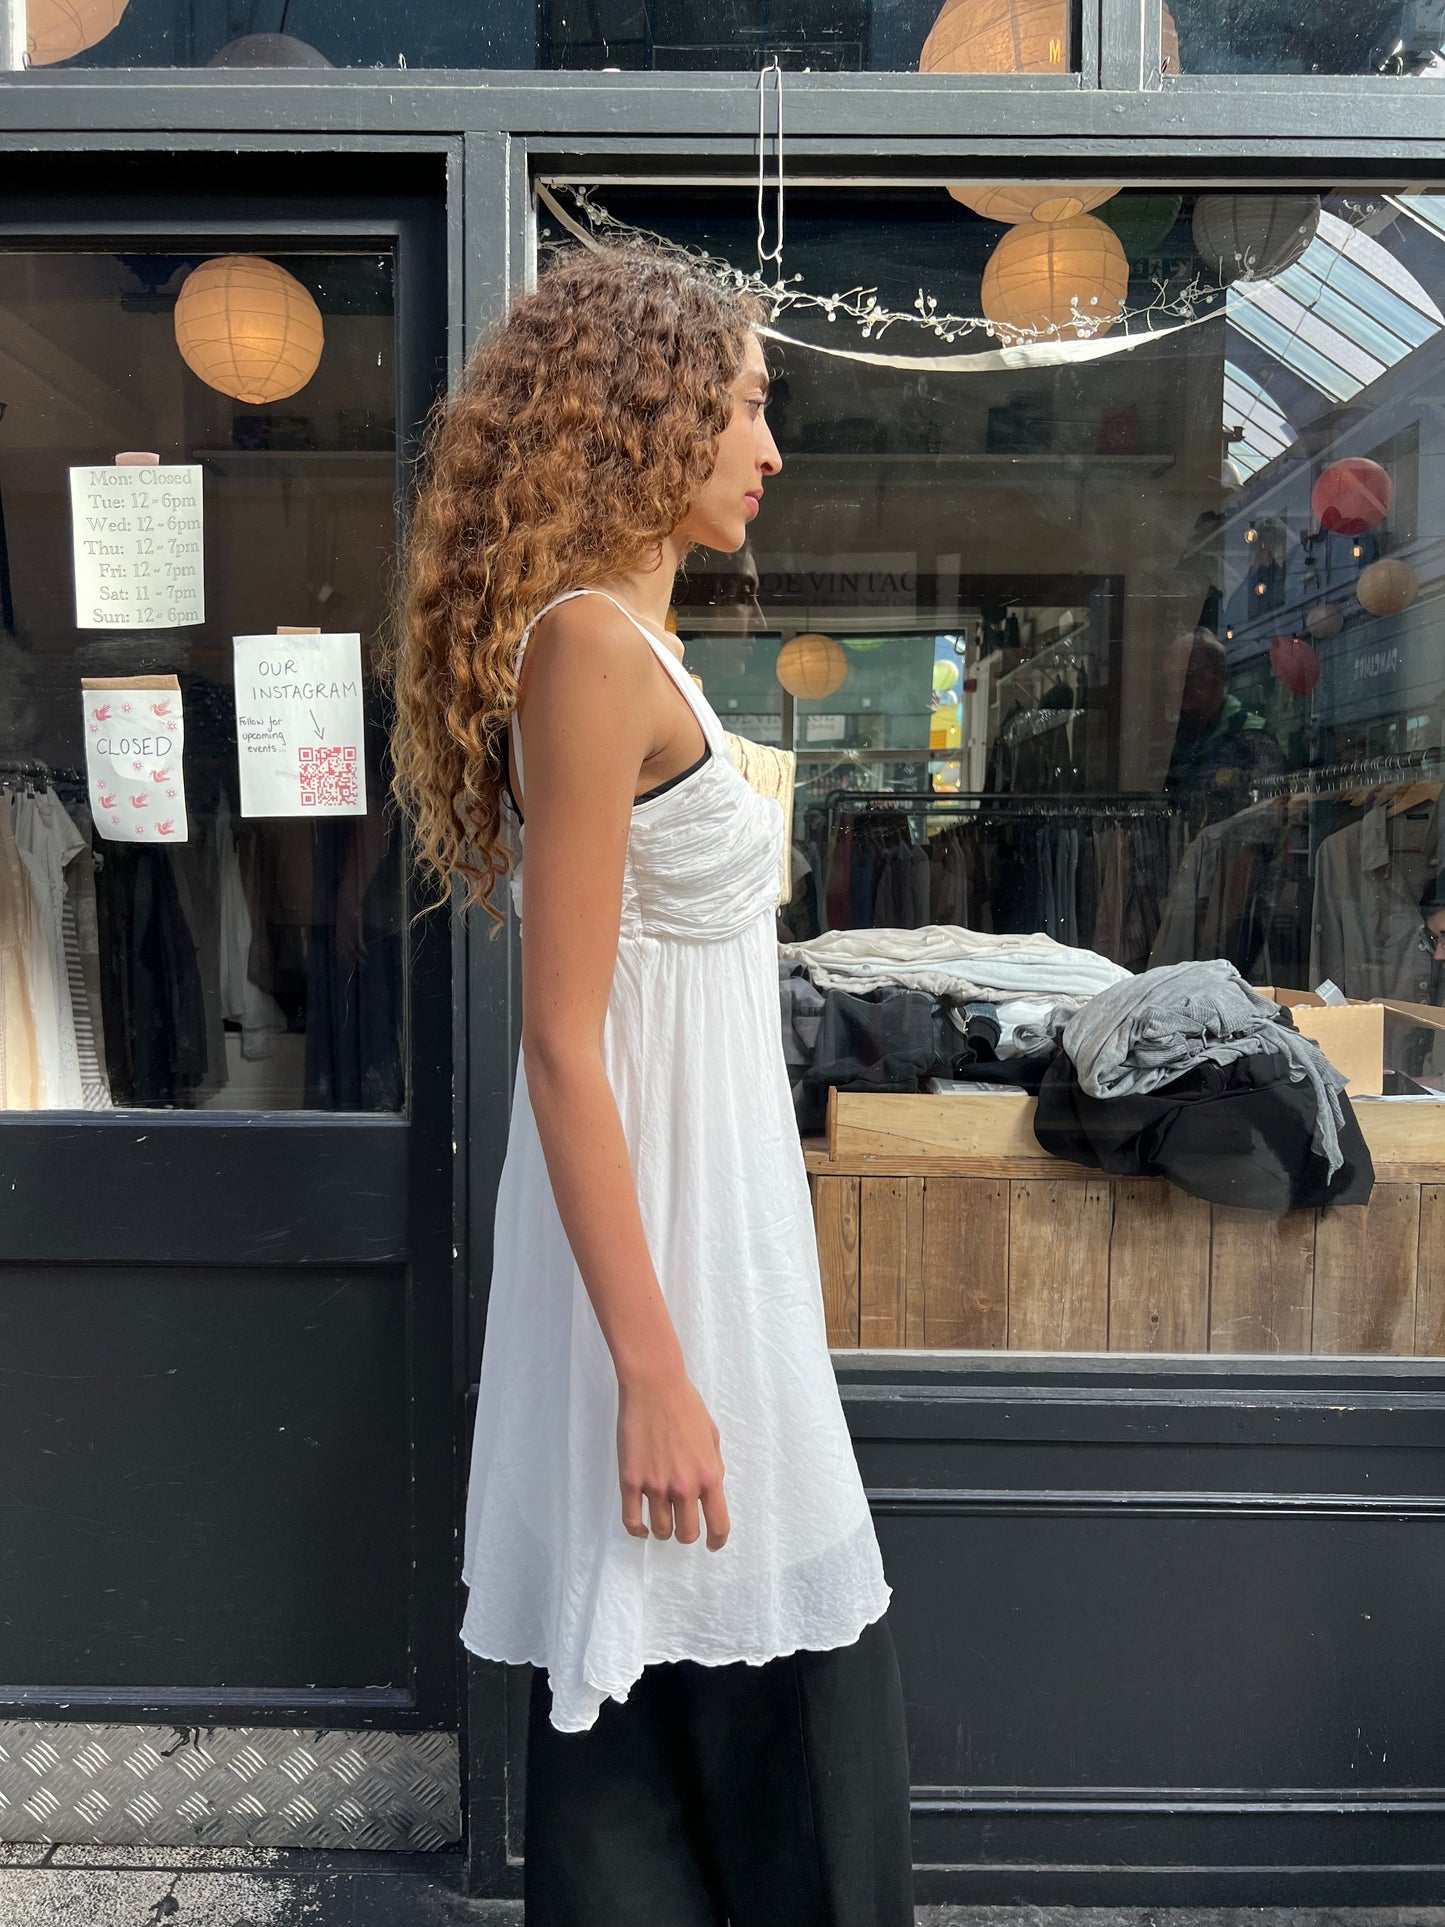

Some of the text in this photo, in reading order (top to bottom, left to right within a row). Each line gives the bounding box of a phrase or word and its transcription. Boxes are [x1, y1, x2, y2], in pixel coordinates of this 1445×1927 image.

[90, 469, 192, 486] Mon: Closed
[88, 494, 125, 509] Tue:
[131, 492, 150, 509] 12
[161, 492, 197, 512] 6pm
[86, 517, 131, 532] Wed:
[136, 515, 154, 532] 12
[167, 515, 201, 535] 6pm
[83, 540, 124, 555] Thu:
[135, 538, 154, 555] 12
[167, 538, 200, 557] 7pm
[98, 563, 127, 578] Fri:
[133, 561, 151, 578] 12
[164, 562, 196, 581] 7pm
[808, 571, 940, 593] VINTAG
[99, 586, 129, 601] Sat:
[135, 586, 150, 601] 11
[166, 585, 197, 603] 7pm
[93, 608, 130, 623] Sun:
[136, 607, 154, 623] 12
[167, 607, 200, 625] 6pm
[258, 659, 298, 676] OUR
[252, 681, 357, 700] INSTAGRAM
[239, 715, 283, 733] Follow for
[96, 736, 172, 757] CLOSED
[242, 731, 287, 747] upcoming
